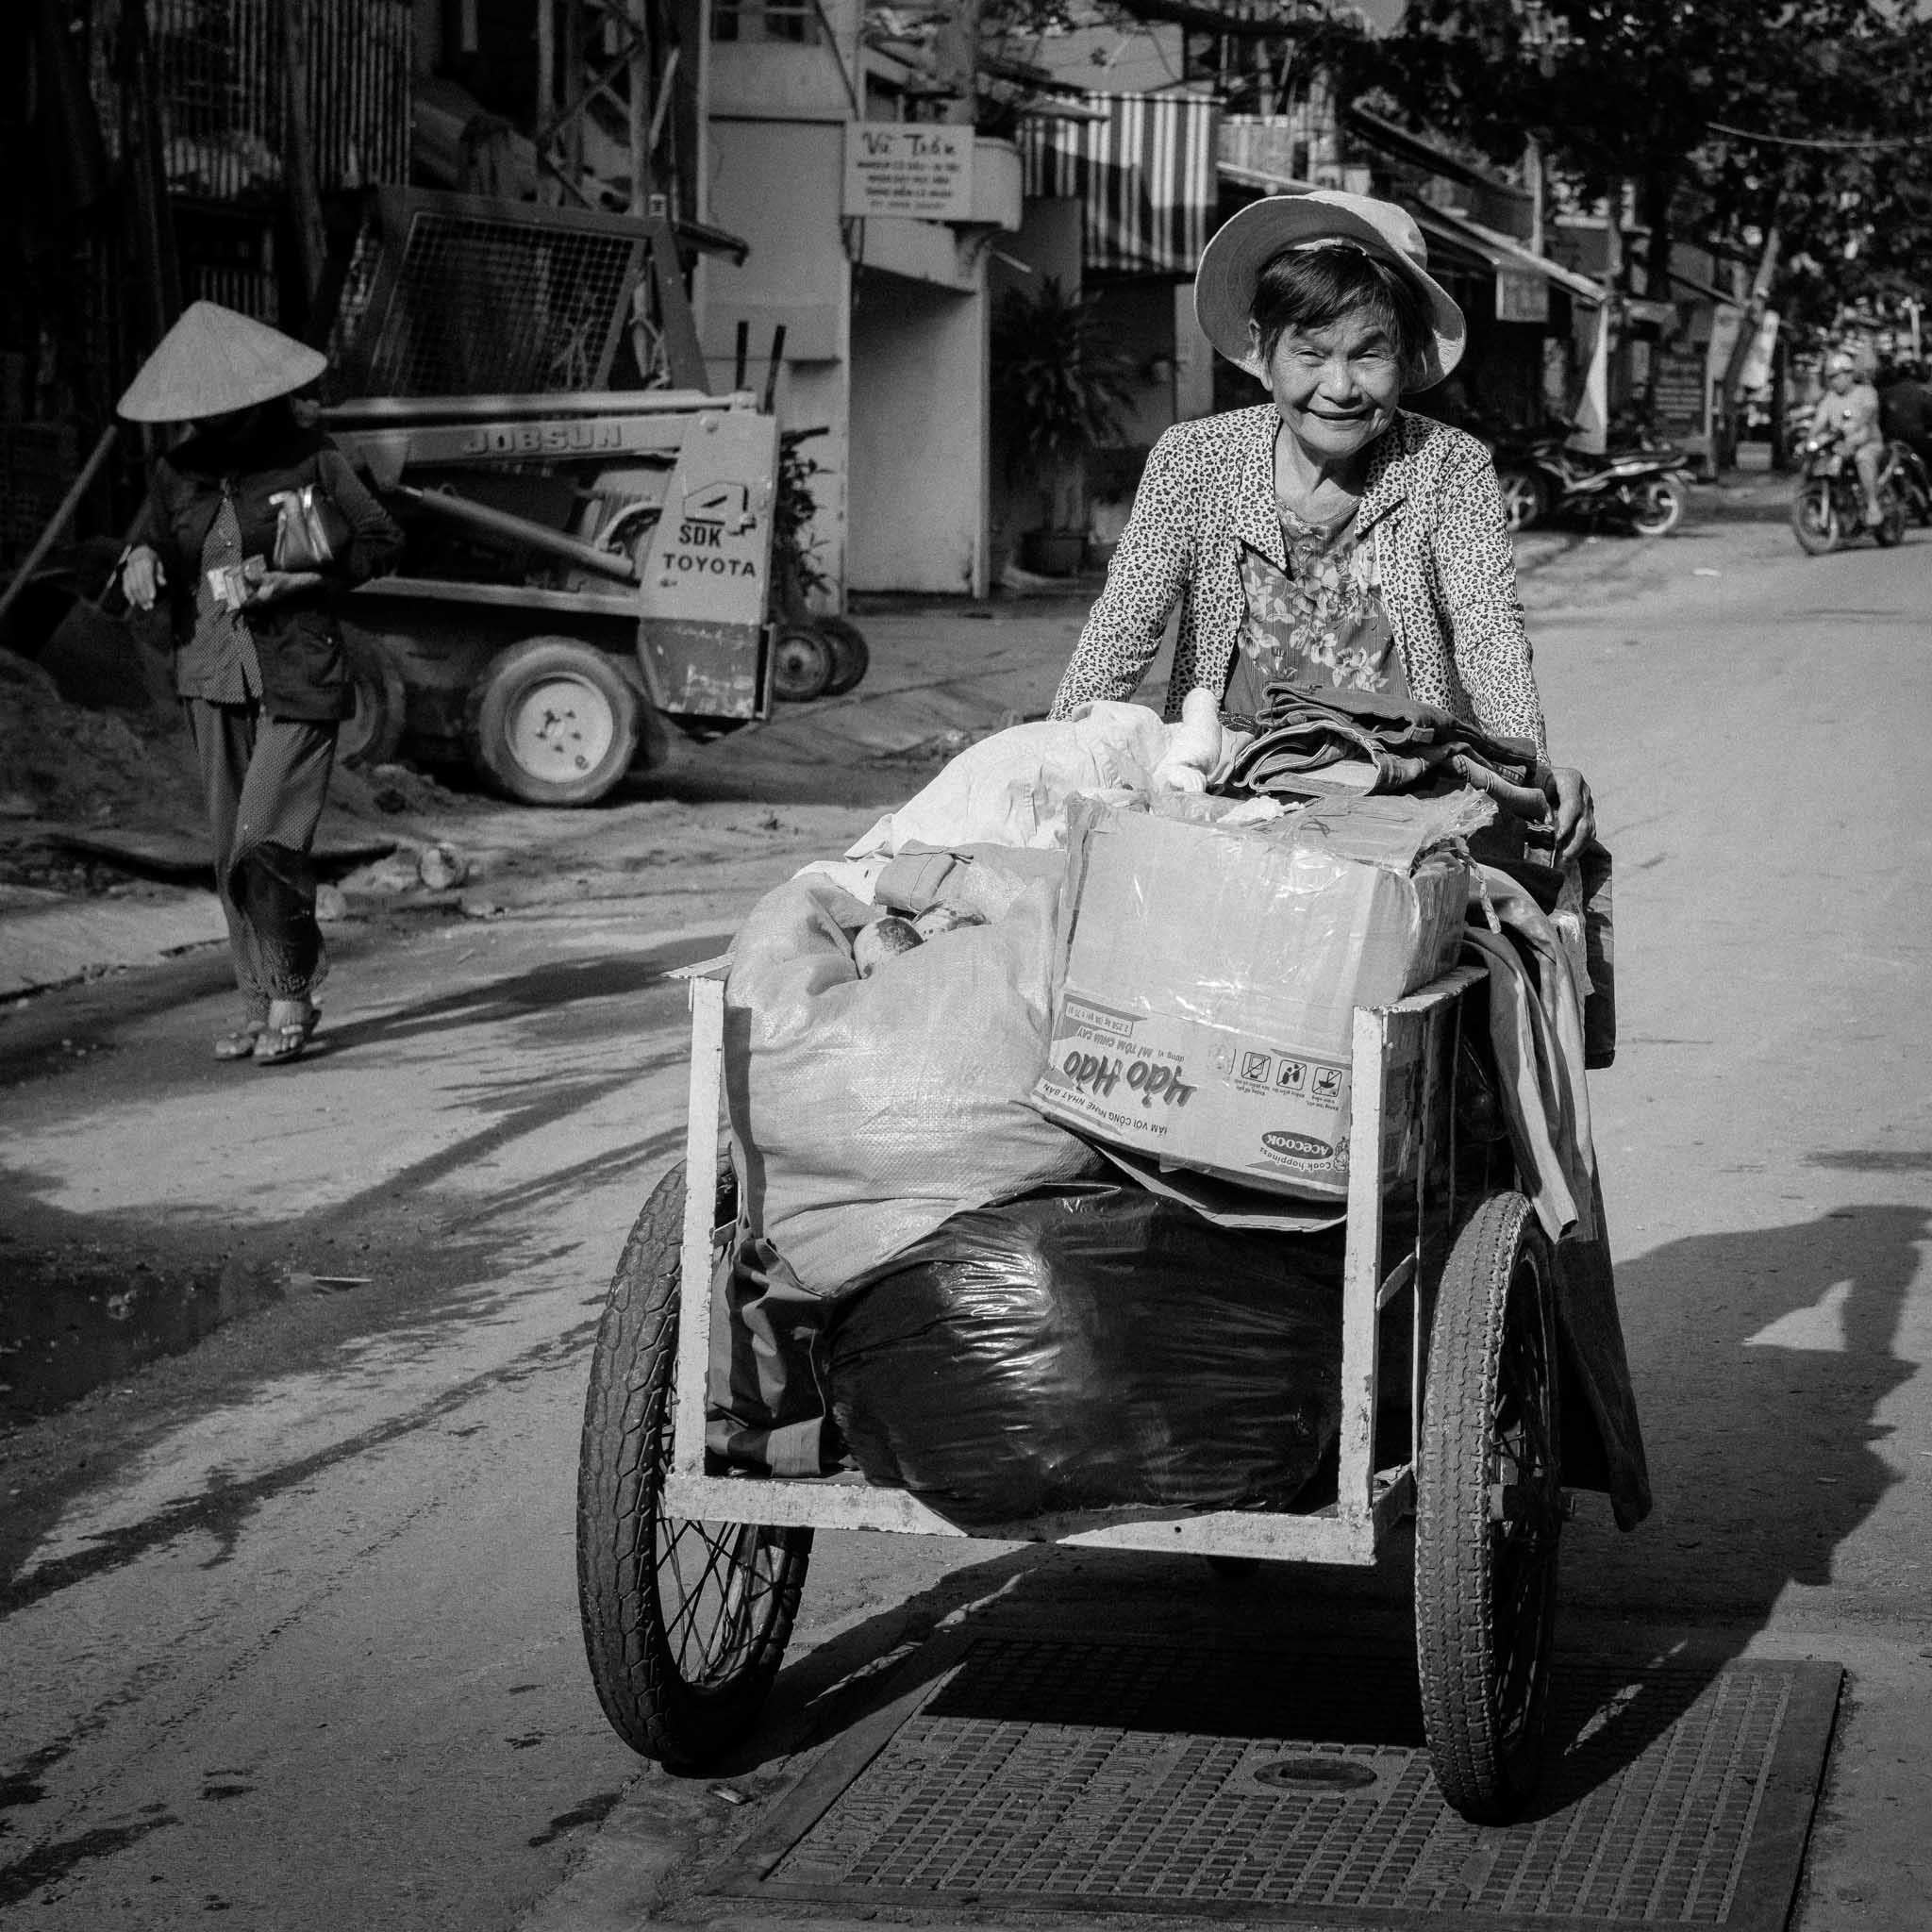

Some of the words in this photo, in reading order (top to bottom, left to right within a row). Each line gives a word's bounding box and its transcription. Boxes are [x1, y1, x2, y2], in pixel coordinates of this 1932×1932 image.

[678, 525, 722, 547] SDK
[662, 553, 756, 577] TOYOTA
[1126, 1060, 1197, 1108] Hảo
[1108, 1111, 1132, 1127] CÔNG
[1259, 1147, 1305, 1172] happiness
[1307, 1161, 1332, 1173] Cook
